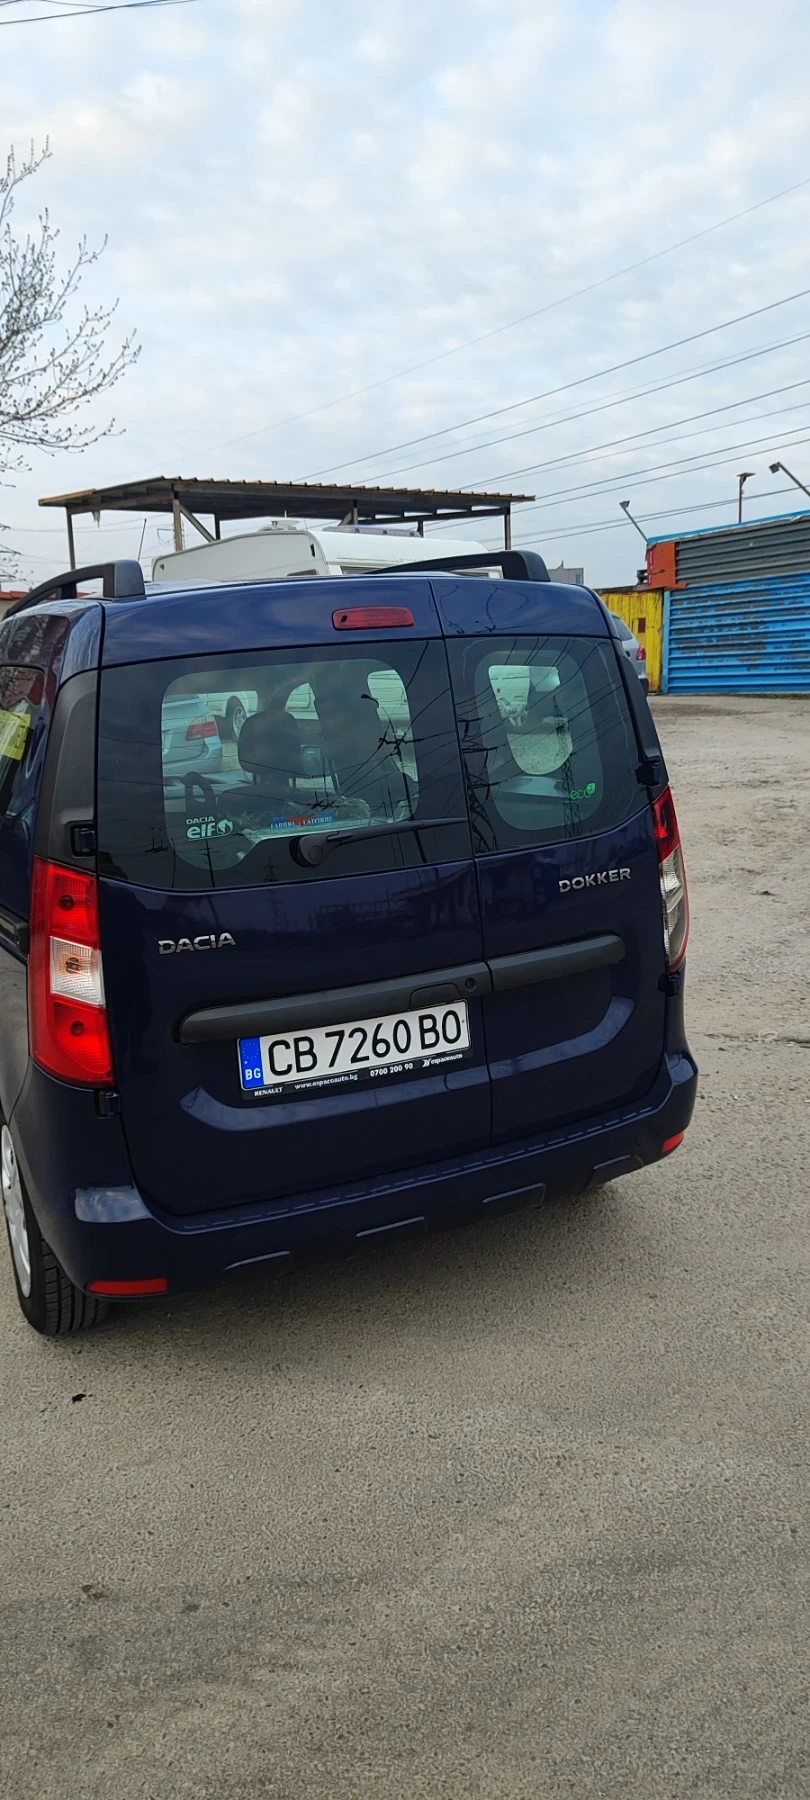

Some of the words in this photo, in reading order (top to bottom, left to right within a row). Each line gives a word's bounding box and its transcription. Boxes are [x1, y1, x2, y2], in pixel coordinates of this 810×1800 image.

[186, 816, 215, 825] DACIA
[186, 822, 215, 839] elf
[558, 867, 631, 893] DOKKER
[158, 932, 236, 954] DACIA
[268, 1036, 318, 1076] CB
[324, 1019, 412, 1068] 7260
[245, 1067, 261, 1080] BG
[370, 1067, 388, 1077] 0700
[389, 1065, 403, 1074] 200
[404, 1062, 414, 1071] 90
[294, 1073, 359, 1090] www.espaceauto.bg
[254, 1086, 283, 1096] RENAULT
